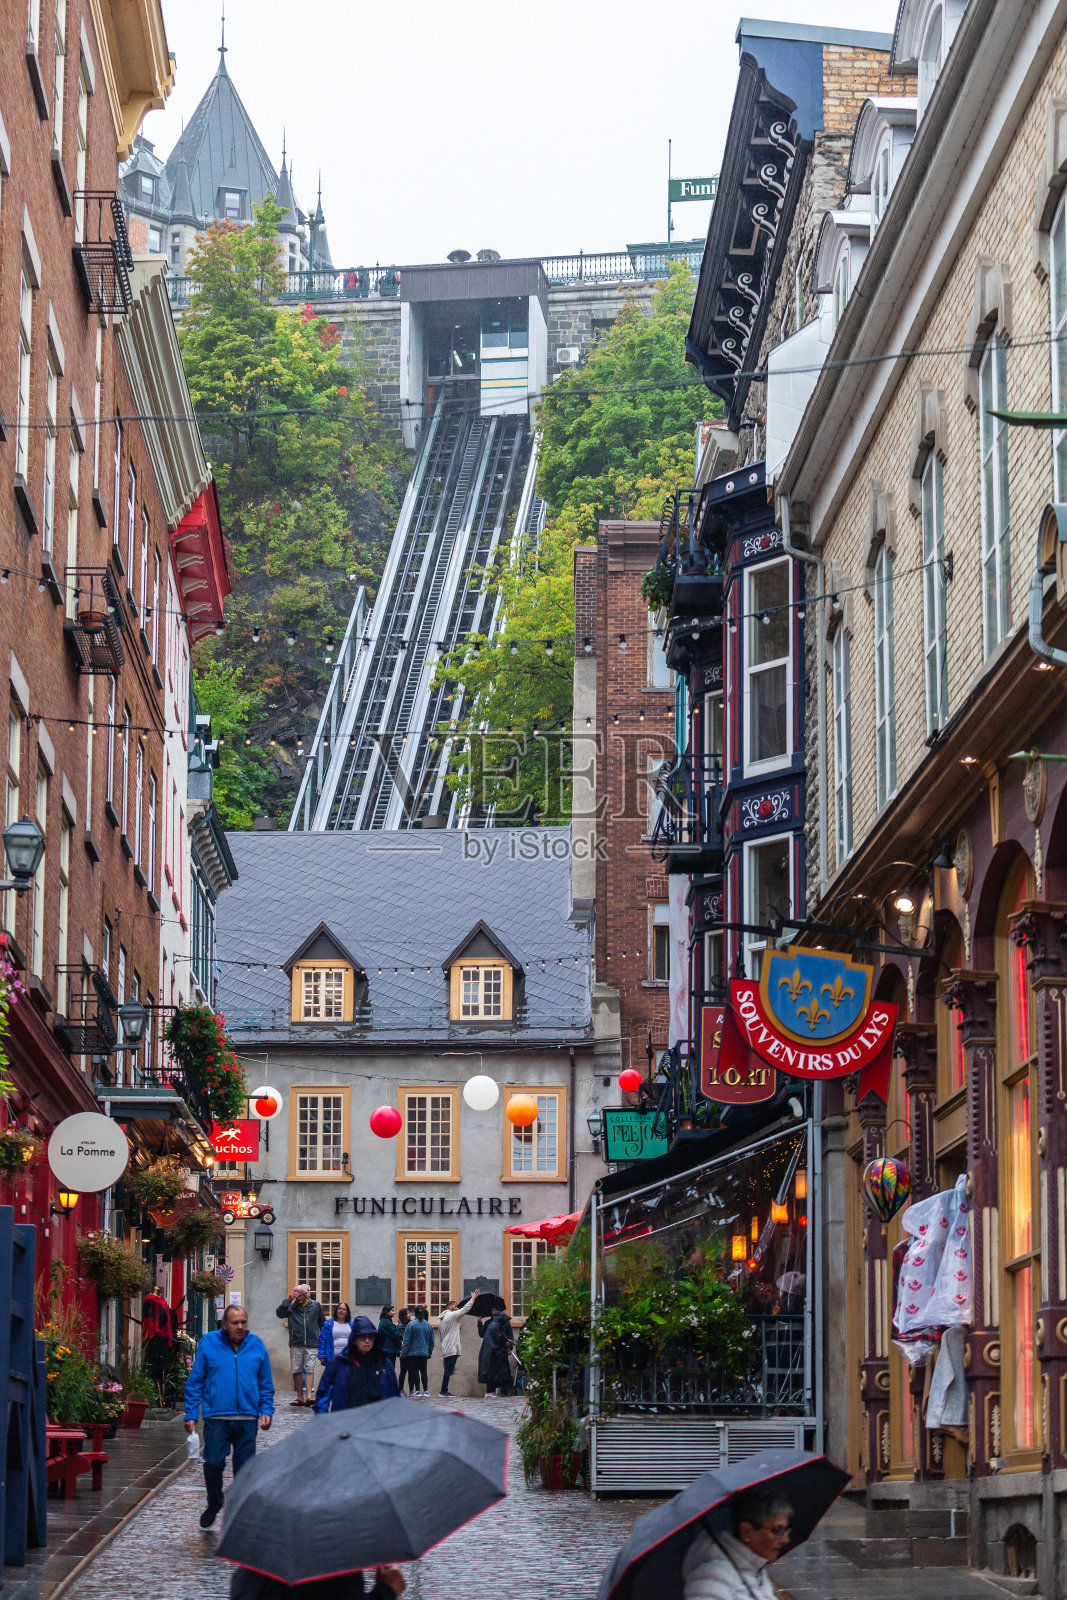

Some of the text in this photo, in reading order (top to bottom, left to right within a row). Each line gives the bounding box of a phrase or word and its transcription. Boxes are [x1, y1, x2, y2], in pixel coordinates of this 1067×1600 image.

[680, 180, 716, 196] Funi
[736, 990, 834, 1071] SOUVENIRS
[836, 1043, 862, 1067] DU
[858, 1010, 889, 1050] LYS
[60, 1145, 116, 1157] La Pomme
[212, 1143, 253, 1154] uchos
[334, 1196, 522, 1216] FUNICULAIRE
[407, 1244, 450, 1253] SOUVNRS
